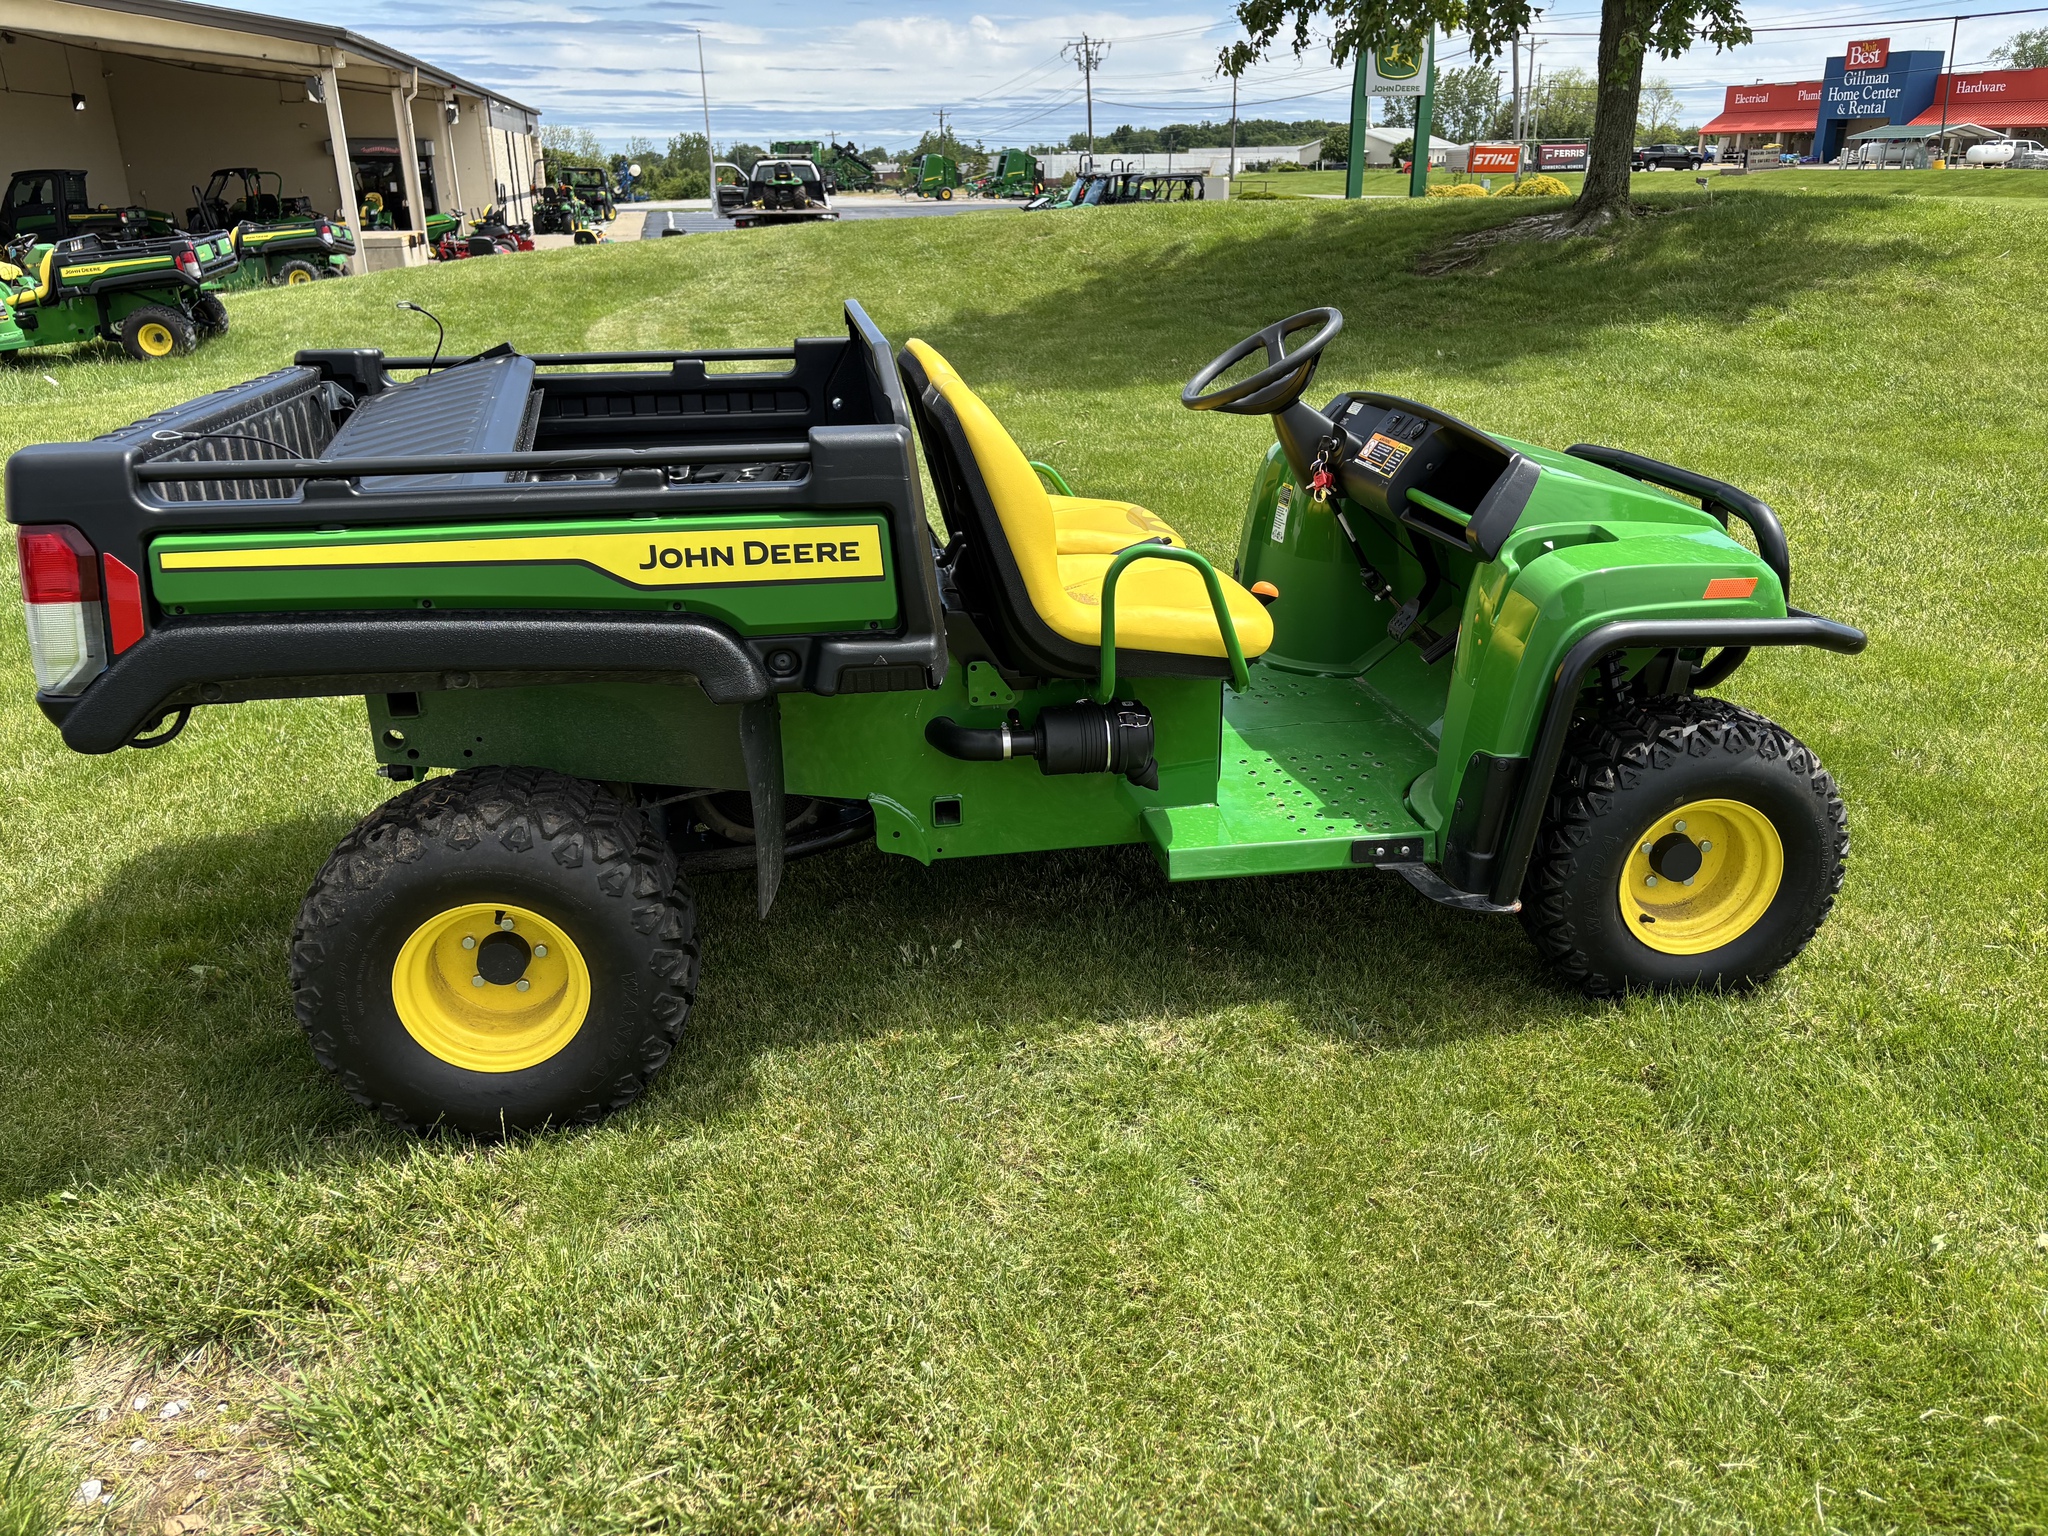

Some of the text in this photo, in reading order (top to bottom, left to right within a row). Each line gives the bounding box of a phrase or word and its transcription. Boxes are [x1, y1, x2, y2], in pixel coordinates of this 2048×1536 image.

[1849, 46, 1881, 65] Best
[1843, 70, 1889, 86] Gillman
[1828, 85, 1901, 101] Home Center
[1956, 80, 2006, 94] Hardware
[1735, 93, 1769, 104] Electrical
[1837, 100, 1886, 115] & Rental
[1473, 153, 1516, 166] STIHL
[1554, 149, 1585, 158] FERRIS
[640, 541, 860, 570] JOHN DEERE
